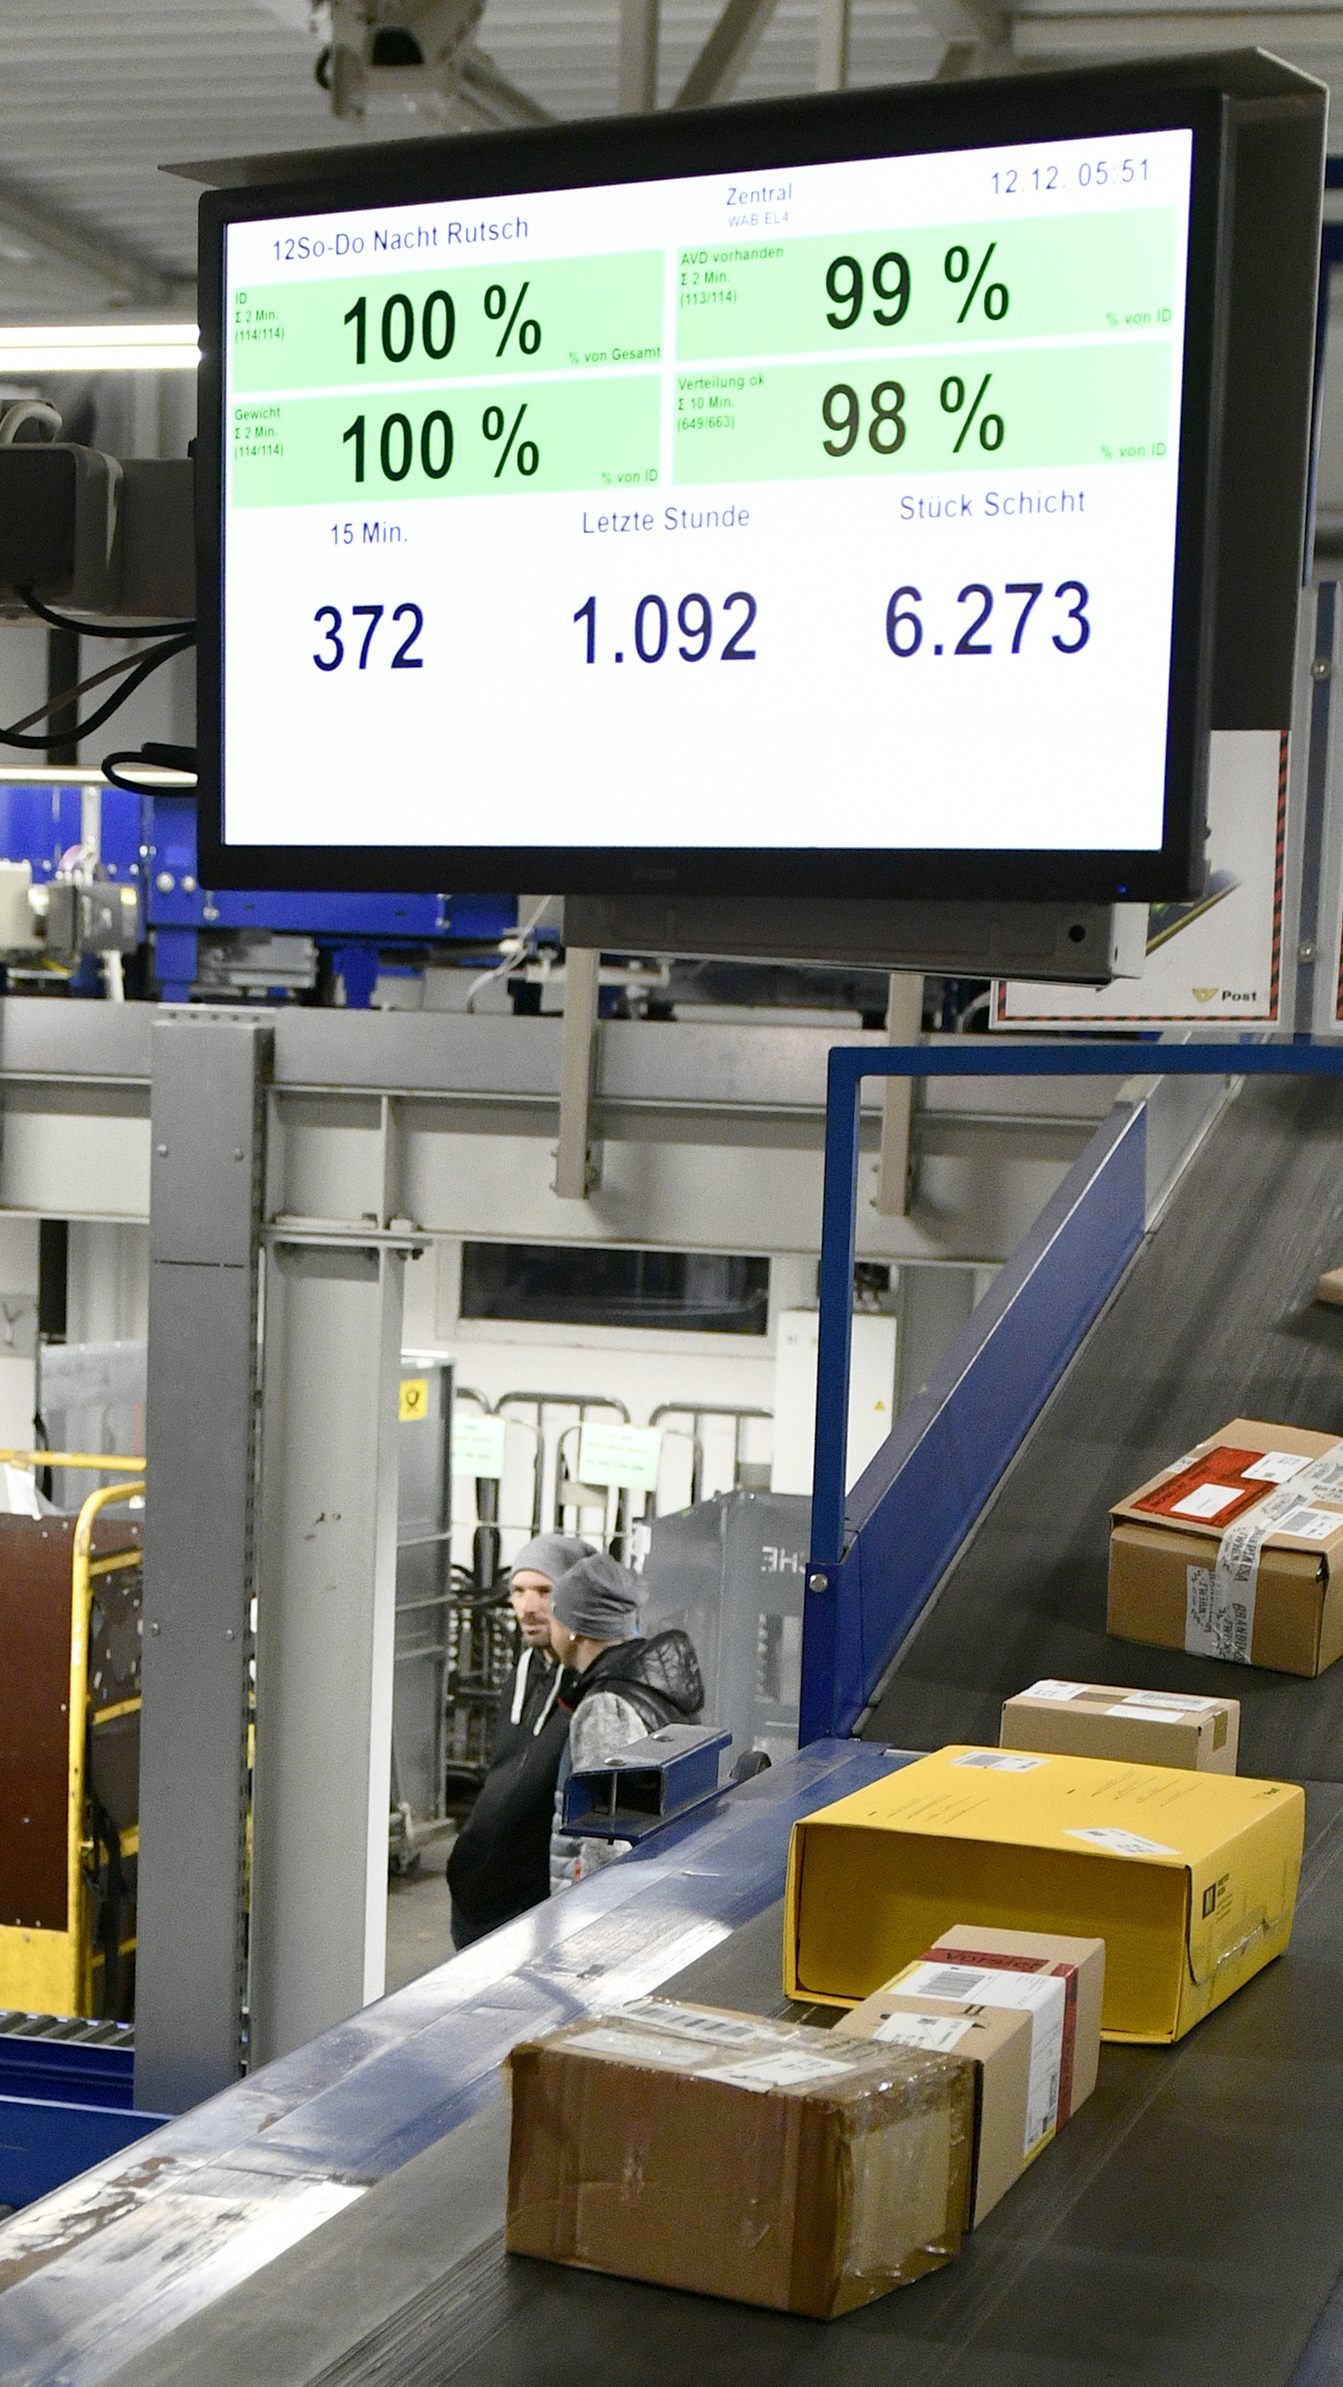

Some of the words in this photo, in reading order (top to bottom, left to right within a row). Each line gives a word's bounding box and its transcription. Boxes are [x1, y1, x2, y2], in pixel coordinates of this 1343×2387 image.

[991, 165, 1065, 195] 12.12.
[1078, 158, 1148, 187] 05:51
[725, 182, 793, 207] Zentral
[728, 212, 759, 228] WAB
[273, 233, 365, 261] 12So-Do
[374, 225, 438, 252] Nacht
[447, 216, 529, 245] Rutsch
[681, 250, 709, 265] AVD
[712, 246, 784, 263] vorhanden
[692, 271, 700, 286] 2
[704, 270, 731, 284] Min.
[825, 251, 912, 331] 99
[943, 241, 1010, 324] %
[235, 291, 248, 305] ID
[680, 289, 737, 308] (113/114)
[245, 310, 252, 323] 2
[255, 309, 279, 321] Min.
[343, 289, 456, 366] 100
[483, 281, 542, 358] %
[1124, 312, 1152, 325] von
[1156, 307, 1172, 323] ID
[234, 326, 285, 343] (114/114)
[584, 351, 608, 363] von
[611, 346, 661, 361] Gesamt
[677, 375, 746, 391] Verteilung
[749, 374, 765, 386] ok
[690, 396, 705, 410] 10
[708, 395, 736, 409] Min.
[234, 406, 281, 421] Gewicht
[821, 380, 907, 458] 98
[939, 373, 1005, 454] %
[244, 426, 252, 439] 2
[254, 425, 278, 438] Min.
[234, 443, 284, 459] (114/114)
[342, 409, 455, 483] 100
[481, 403, 540, 479] %
[1118, 446, 1146, 458] von
[1151, 441, 1167, 457] ID
[616, 472, 641, 484] von
[644, 468, 658, 482] ID
[900, 493, 973, 521] Stück
[984, 489, 1085, 517] Schicht
[582, 511, 654, 534] Letzte
[664, 504, 750, 531] Stunde
[330, 522, 354, 545] 15
[362, 521, 408, 544] Min.
[573, 590, 757, 665] 1.092
[885, 579, 1091, 658] 6.273
[312, 602, 424, 672] 372
[1221, 989, 1257, 1001] Post
